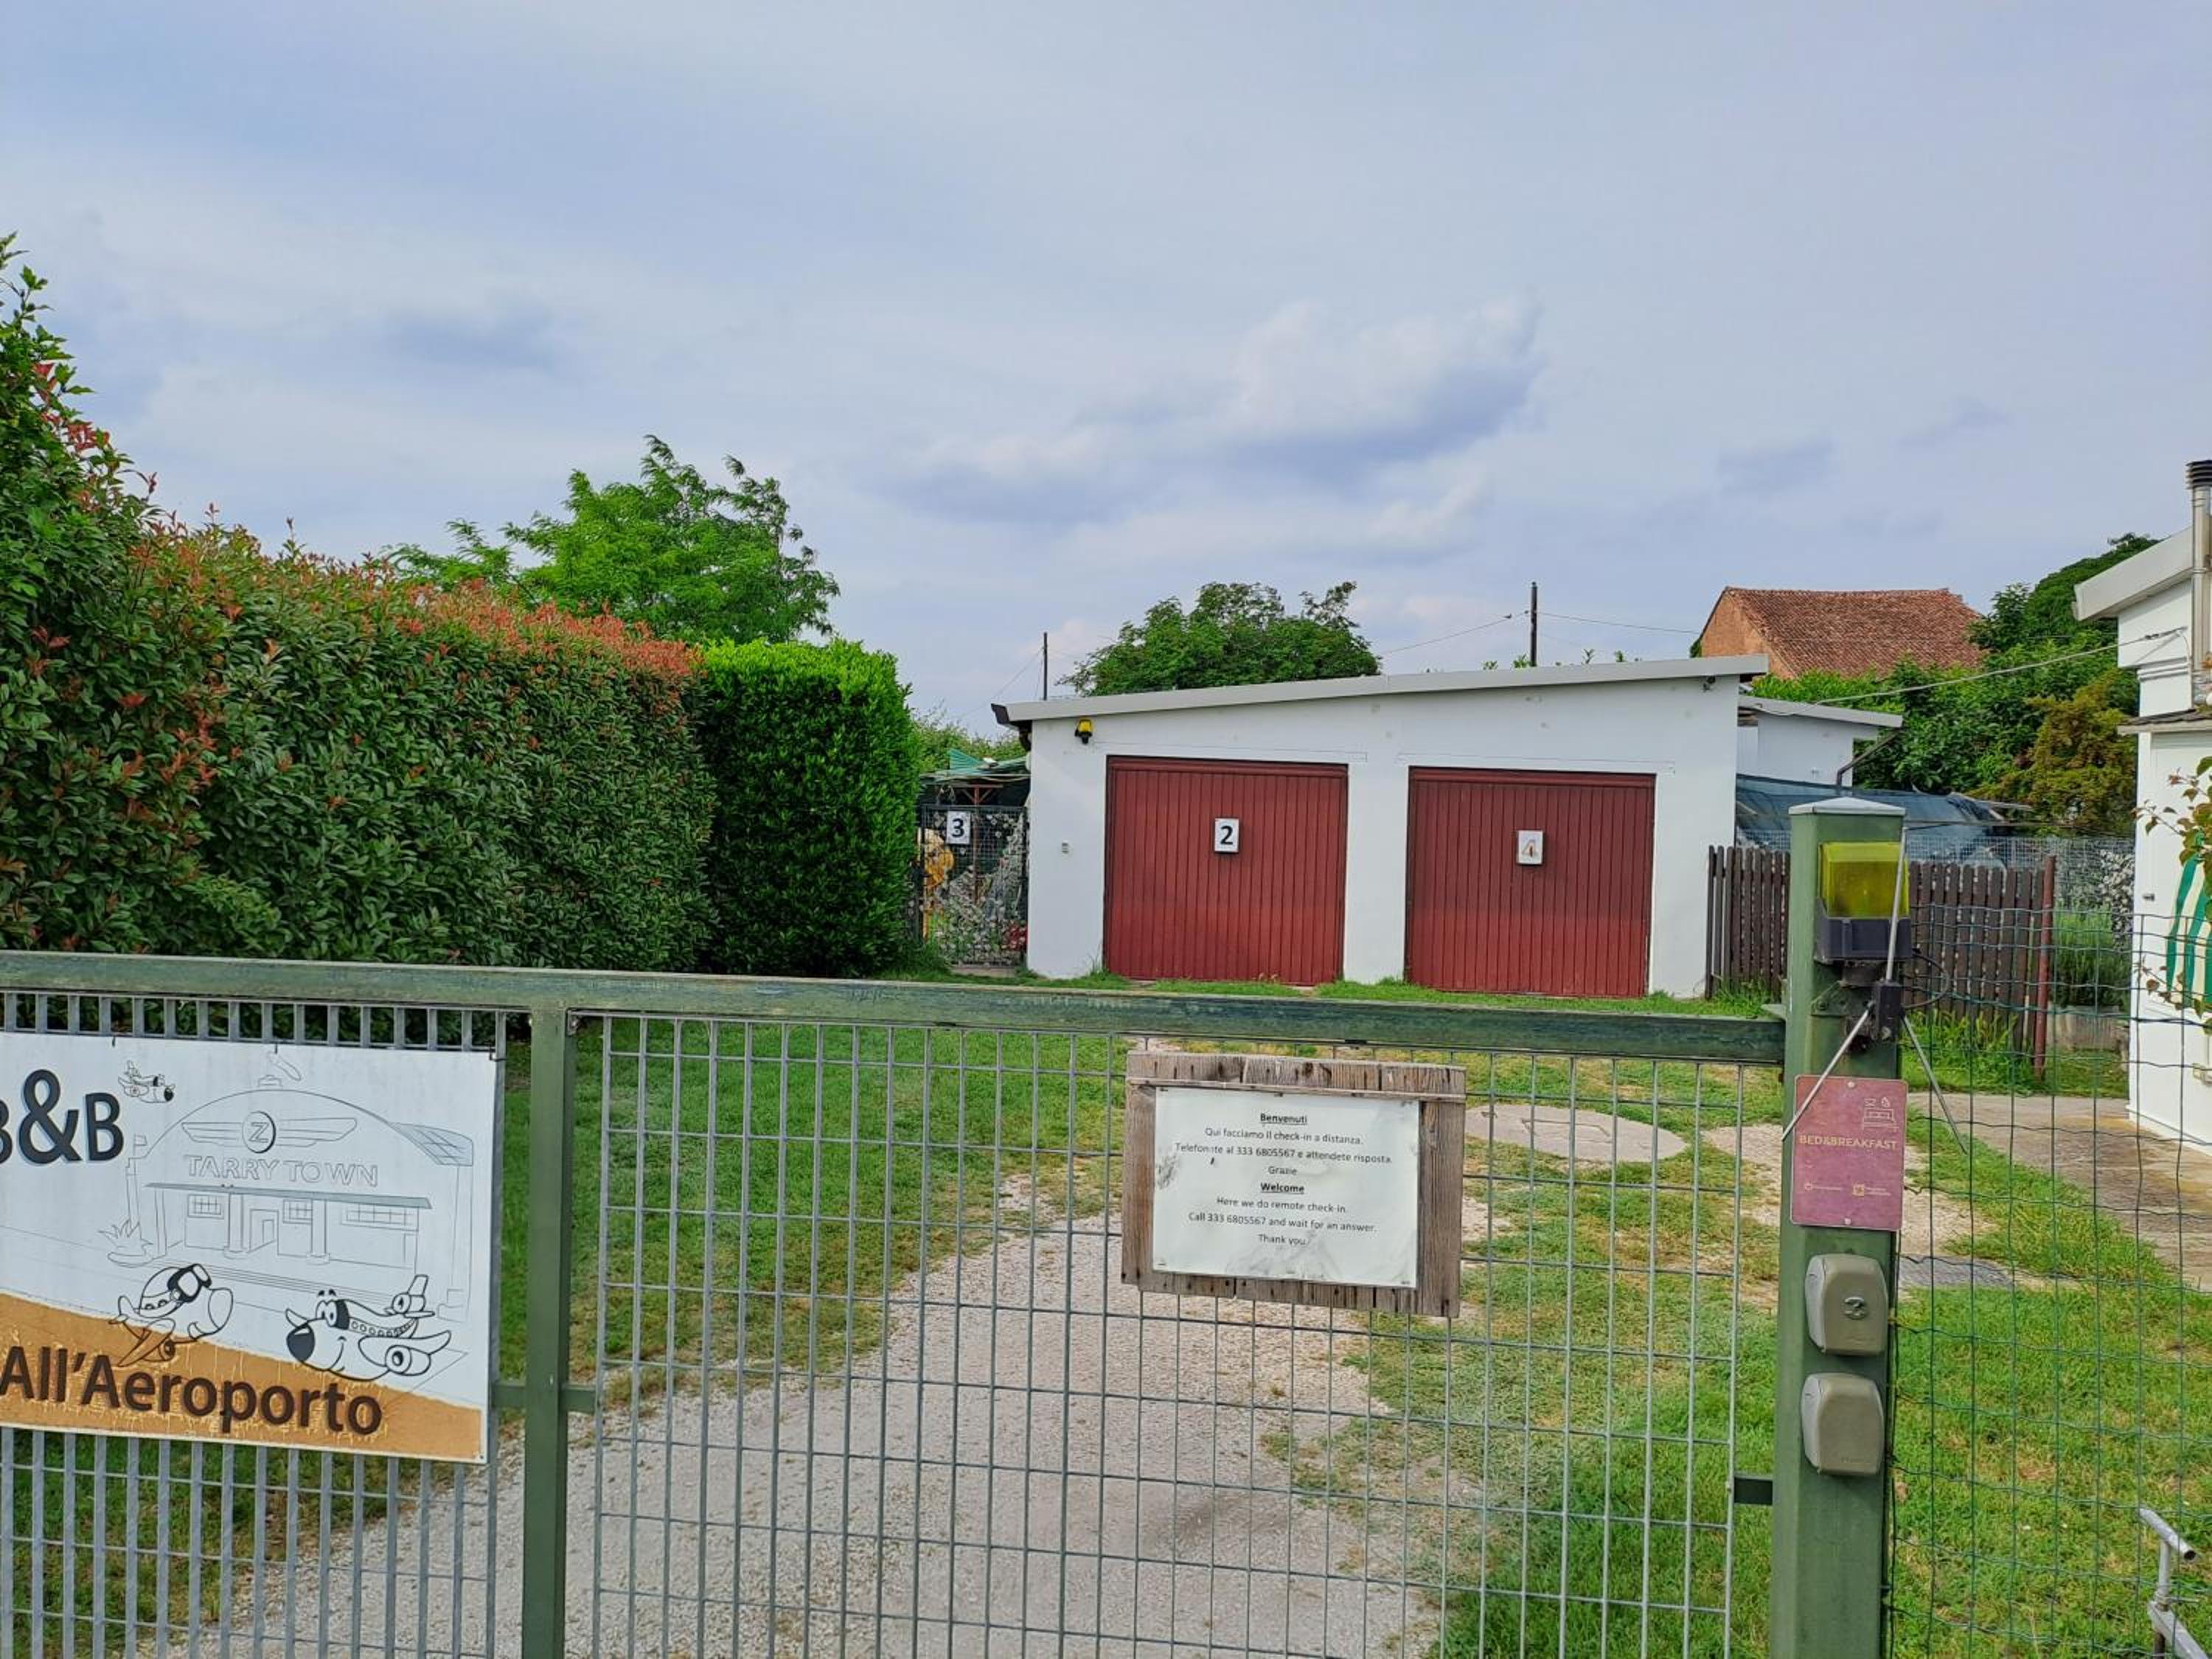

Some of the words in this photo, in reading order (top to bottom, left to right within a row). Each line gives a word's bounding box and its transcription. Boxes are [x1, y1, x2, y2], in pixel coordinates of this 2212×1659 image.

[951, 818, 964, 839] 3
[1220, 825, 1234, 845] 2
[1259, 1113, 1307, 1124] Benvenuti
[1205, 1127, 1221, 1137] Qui
[1223, 1127, 1264, 1139] facciamo
[1266, 1130, 1272, 1139] il
[1273, 1131, 1312, 1141] check-in
[1322, 1134, 1363, 1145] distanza.
[1799, 1135, 1897, 1150] BED&BREAKFAST
[1226, 1146, 1234, 1155] al
[1237, 1147, 1253, 1155] 333
[1256, 1148, 1295, 1158] 6805567
[1306, 1151, 1351, 1161] attendete
[184, 1155, 279, 1180] TARRY
[283, 1160, 378, 1186] TOWN
[1268, 1166, 1298, 1175] Grazie
[1260, 1182, 1304, 1194] Welcome
[1217, 1197, 1239, 1206] Here
[1256, 1199, 1269, 1208] do
[1271, 1202, 1304, 1210] remote
[1189, 1212, 1206, 1222] Call
[1207, 1213, 1224, 1222] 333
[1226, 1214, 1266, 1225] 6805567
[1269, 1218, 1286, 1226] and
[1288, 1220, 1308, 1228] wait
[1310, 1219, 1324, 1229] for
[1257, 1234, 1285, 1244] Thank
